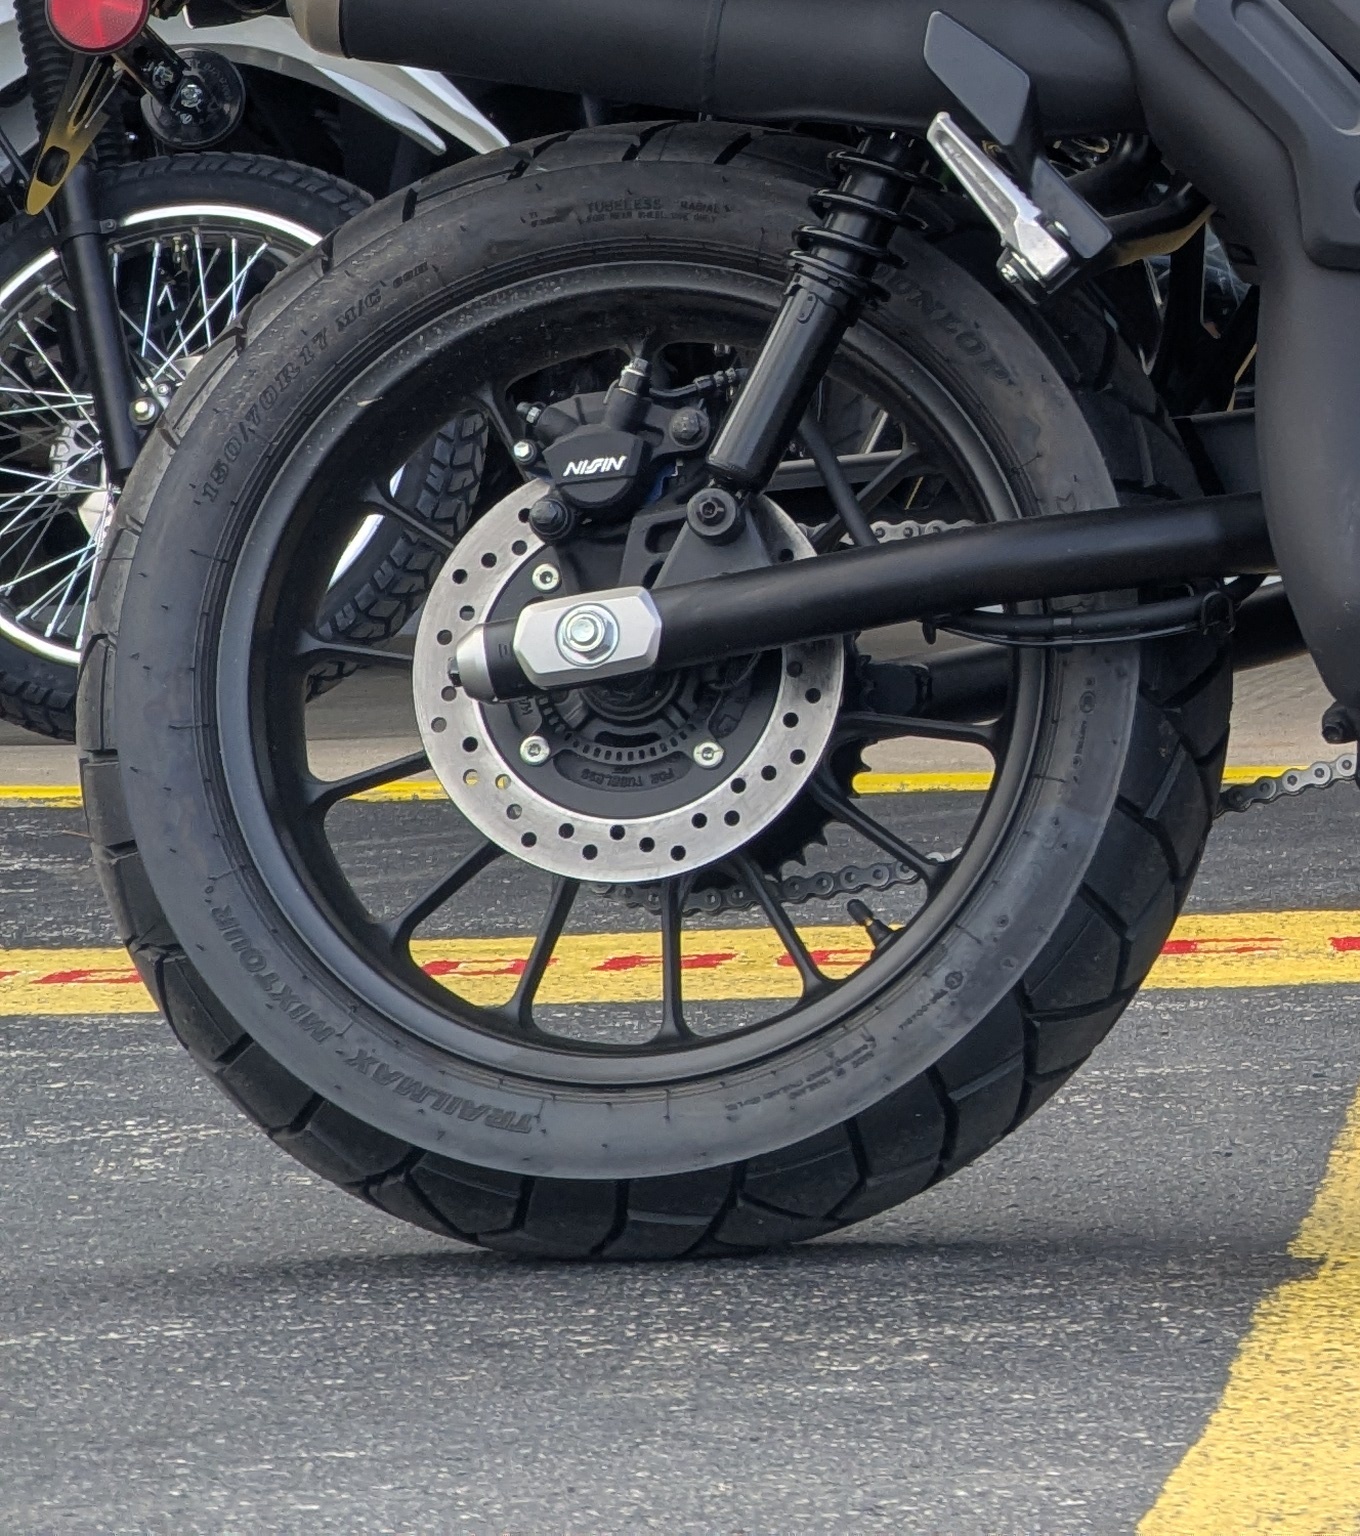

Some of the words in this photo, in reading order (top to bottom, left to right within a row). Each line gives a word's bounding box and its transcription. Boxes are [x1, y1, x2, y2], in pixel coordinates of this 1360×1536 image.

[562, 455, 628, 477] NISSIN
[208, 904, 338, 1046] MIXTOUR
[341, 1046, 535, 1135] TRAILMAX
